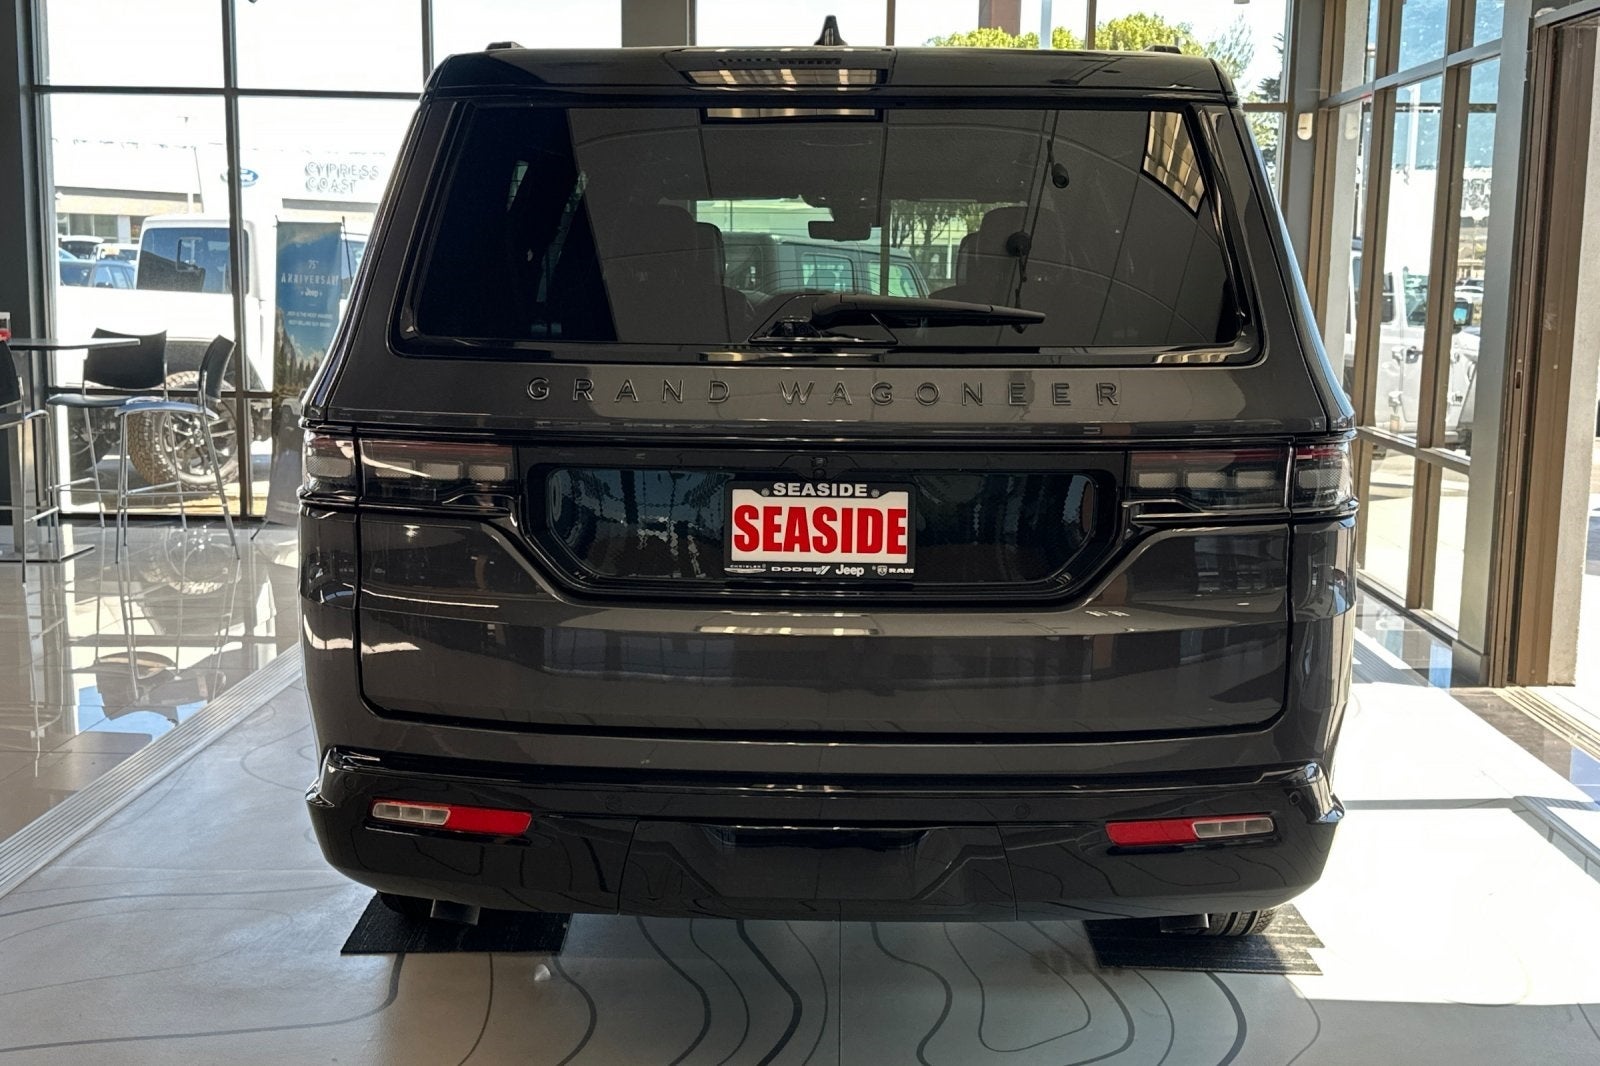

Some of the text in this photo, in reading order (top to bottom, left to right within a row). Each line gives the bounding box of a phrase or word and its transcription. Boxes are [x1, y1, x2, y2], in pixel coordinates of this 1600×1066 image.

[305, 161, 379, 179] CYPRESS
[306, 177, 358, 191] COAST
[526, 376, 1121, 407] GRAND WAGONEER
[773, 482, 868, 497] SEASIDE
[734, 505, 907, 554] SEASIDE
[835, 564, 865, 577] Jeep
